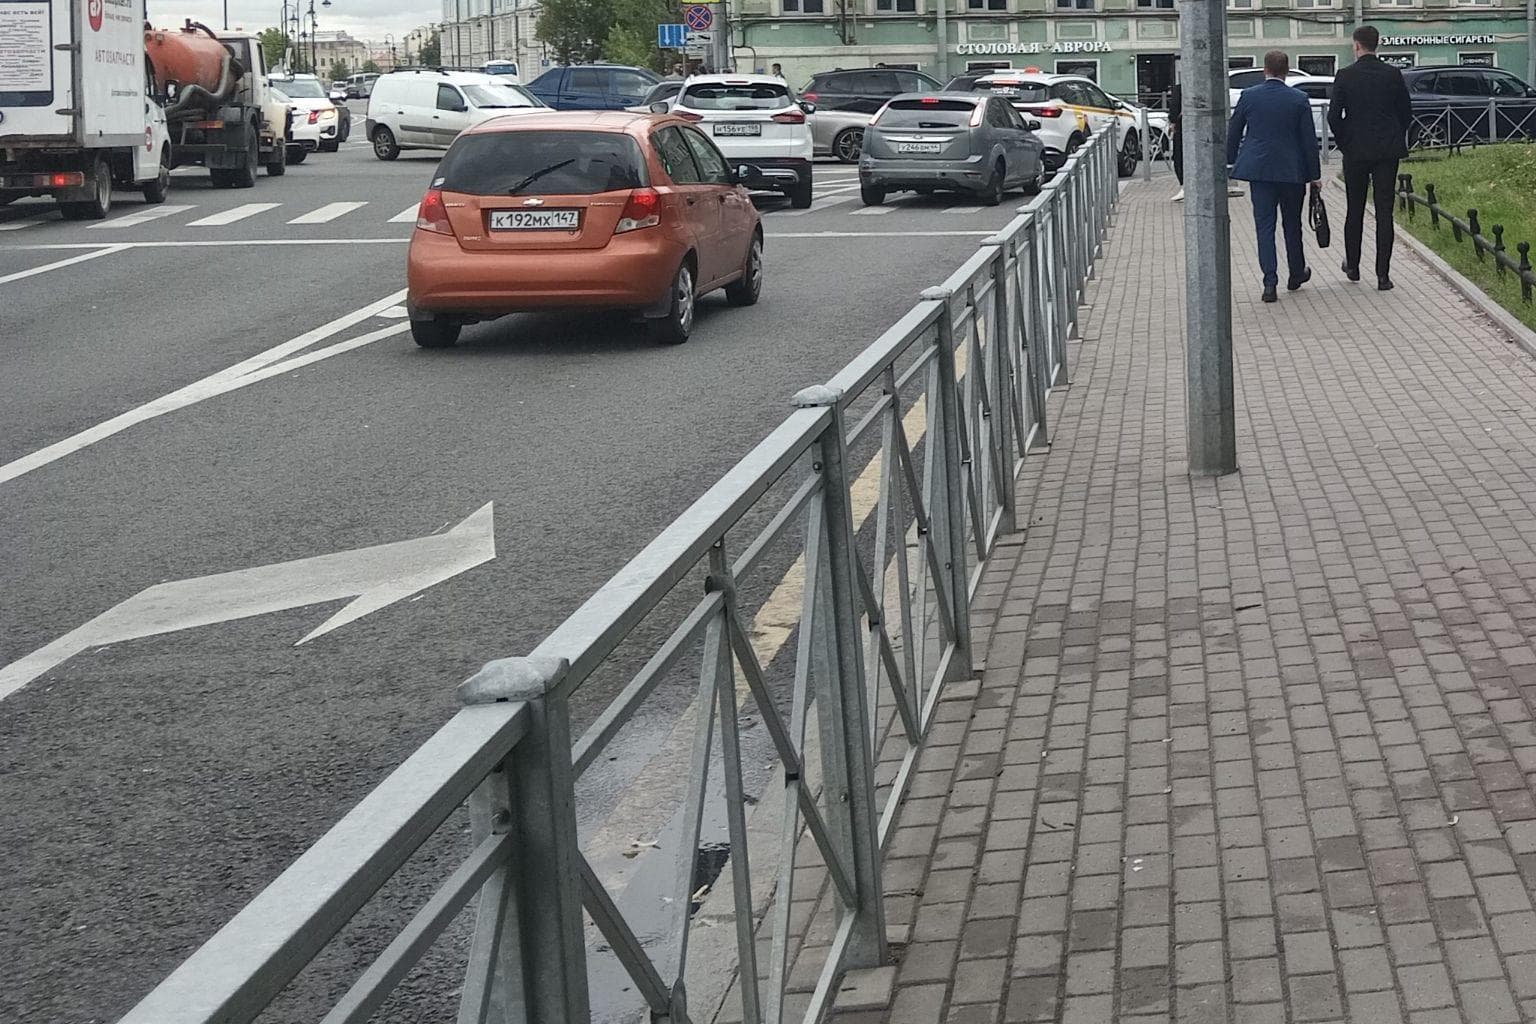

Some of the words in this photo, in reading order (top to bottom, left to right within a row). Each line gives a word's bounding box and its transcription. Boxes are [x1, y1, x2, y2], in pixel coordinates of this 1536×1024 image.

[1382, 36, 1448, 46] ЭЛЕКТРОННЫЕ
[1449, 35, 1495, 44] СИГАРЕТЫ
[956, 42, 1040, 55] СТОЛОВАЯ
[1051, 41, 1113, 54] АВРОРА
